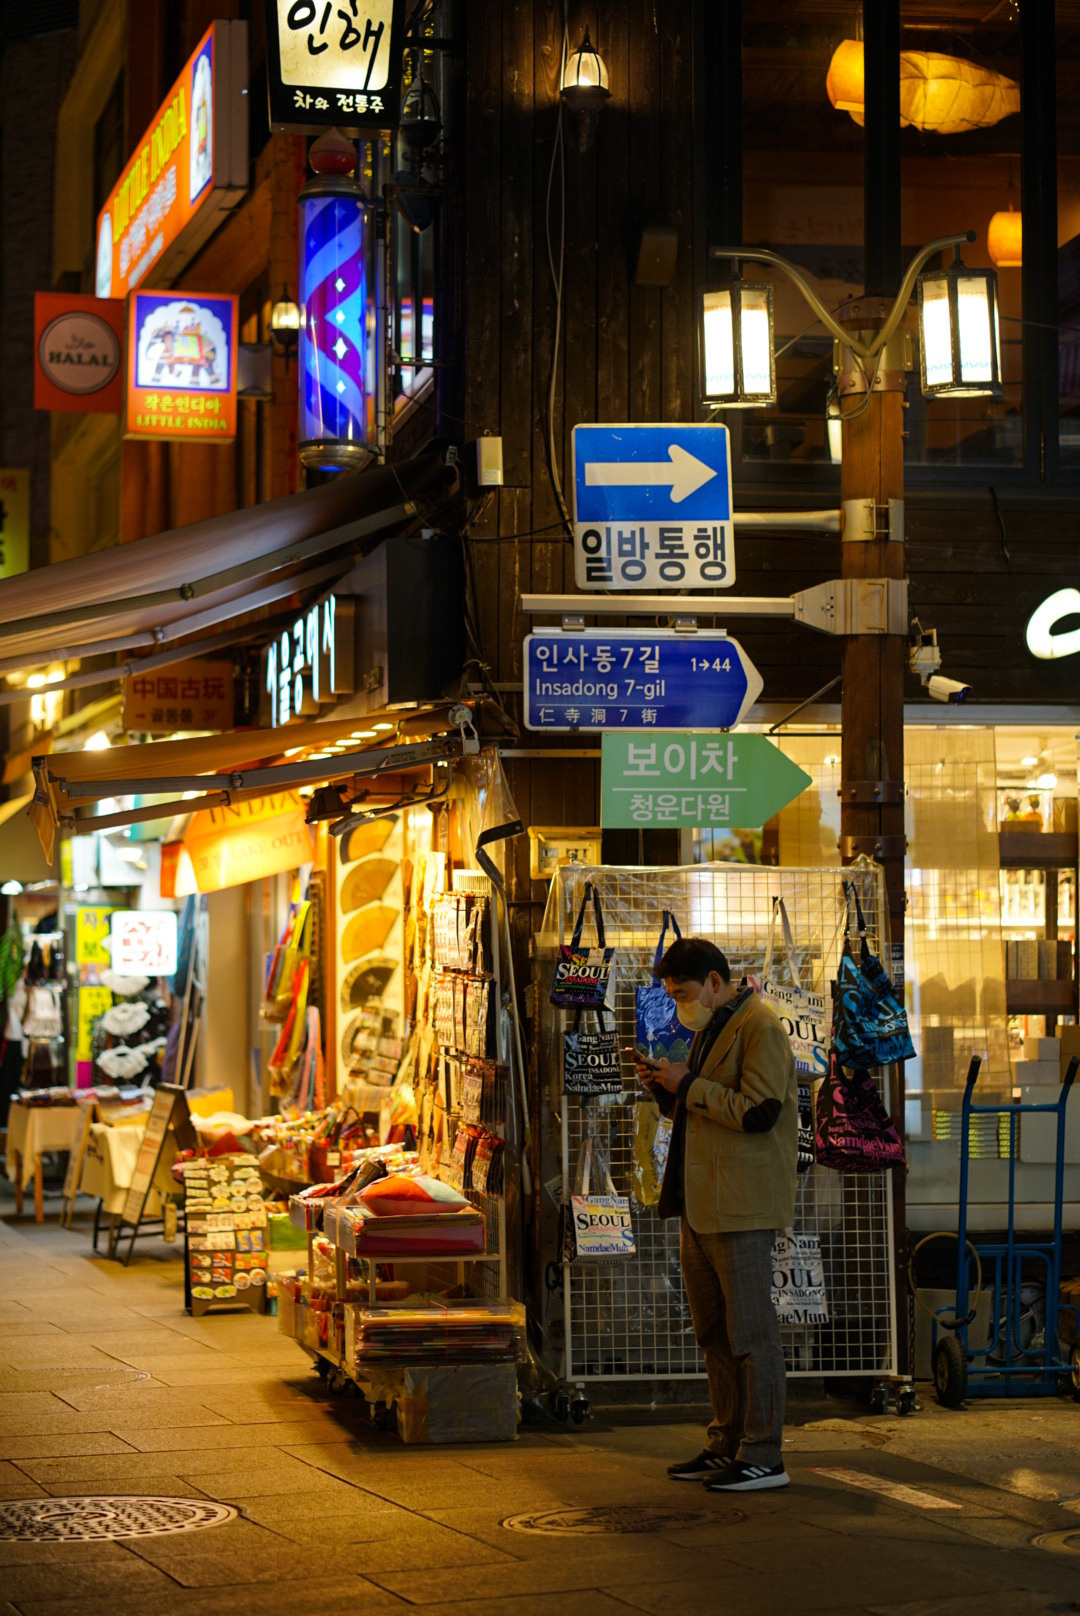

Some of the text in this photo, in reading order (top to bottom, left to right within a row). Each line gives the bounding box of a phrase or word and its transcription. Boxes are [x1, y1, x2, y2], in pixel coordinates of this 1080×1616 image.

[293, 90, 385, 114] 차와 전통주
[113, 143, 150, 244] LITTLE
[150, 85, 187, 184] INDIA
[48, 350, 113, 367] HALAL
[136, 413, 228, 430] LITTLE INDIA
[581, 525, 727, 582] 일방통행
[536, 644, 661, 674] 인사동7길
[133, 677, 225, 700] 中国古玩
[536, 678, 665, 700] Insadong 7-gil
[623, 741, 738, 781] 보이차
[629, 794, 730, 821] 청운다원
[271, 831, 304, 850] OUT
[557, 963, 608, 980] SEOUL
[780, 1016, 825, 1044] OUL
[565, 1051, 620, 1069] SEOUL
[565, 1071, 593, 1080] Korea
[565, 1082, 623, 1092] NamdaeMun
[828, 1133, 901, 1153] NamdaeMun
[577, 1213, 630, 1230] SEOUL
[579, 1243, 629, 1253] NamdaeMun
[774, 1236, 821, 1254] gNam
[772, 1268, 822, 1289] OUL
[778, 1288, 825, 1298] INSADONG
[777, 1309, 828, 1324] aeMun
